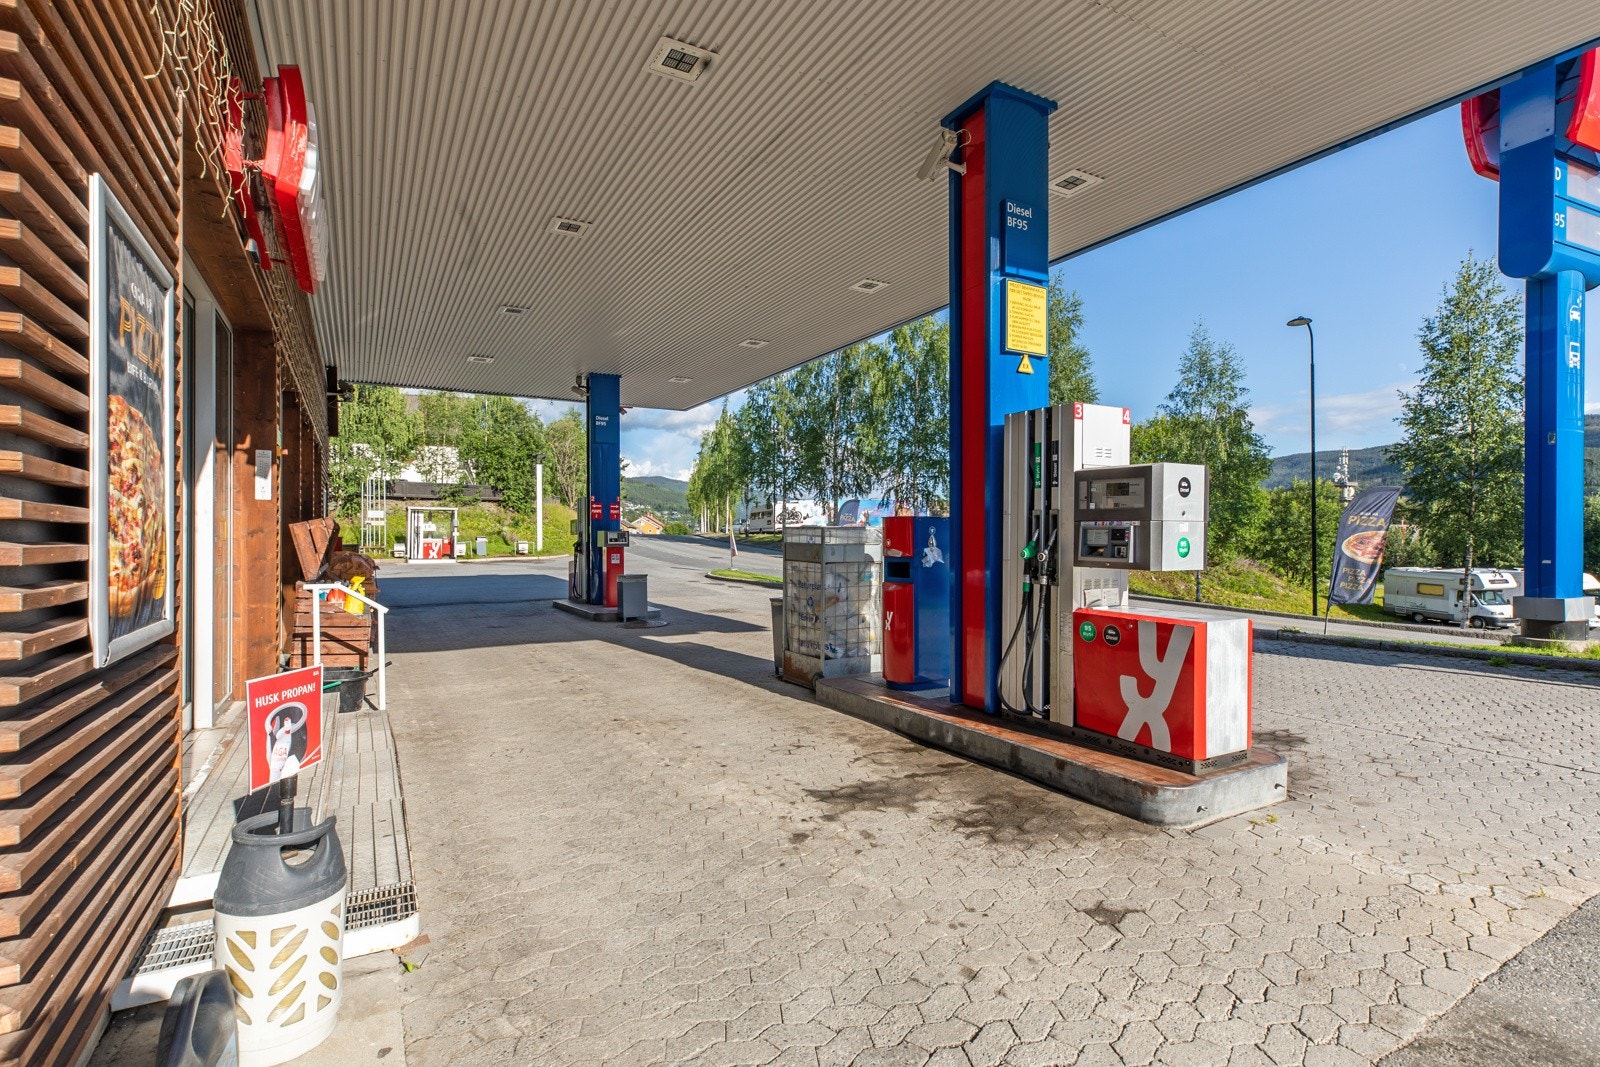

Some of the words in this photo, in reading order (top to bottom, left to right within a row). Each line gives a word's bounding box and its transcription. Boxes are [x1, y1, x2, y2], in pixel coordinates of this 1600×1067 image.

[1555, 166, 1561, 181] D
[1007, 202, 1032, 218] Diesel
[1007, 216, 1028, 230] BF95
[1554, 212, 1565, 228] 95
[120, 295, 162, 378] PIZZA
[1075, 404, 1082, 418] 3
[1123, 411, 1130, 422] 4
[1347, 515, 1386, 527] PIZZA
[1342, 567, 1366, 576] PIZZA
[1340, 581, 1364, 591] PIZZA
[1347, 575, 1371, 584] PIZZA
[255, 692, 279, 708] HUSK
[281, 682, 316, 701] PROPAN!
